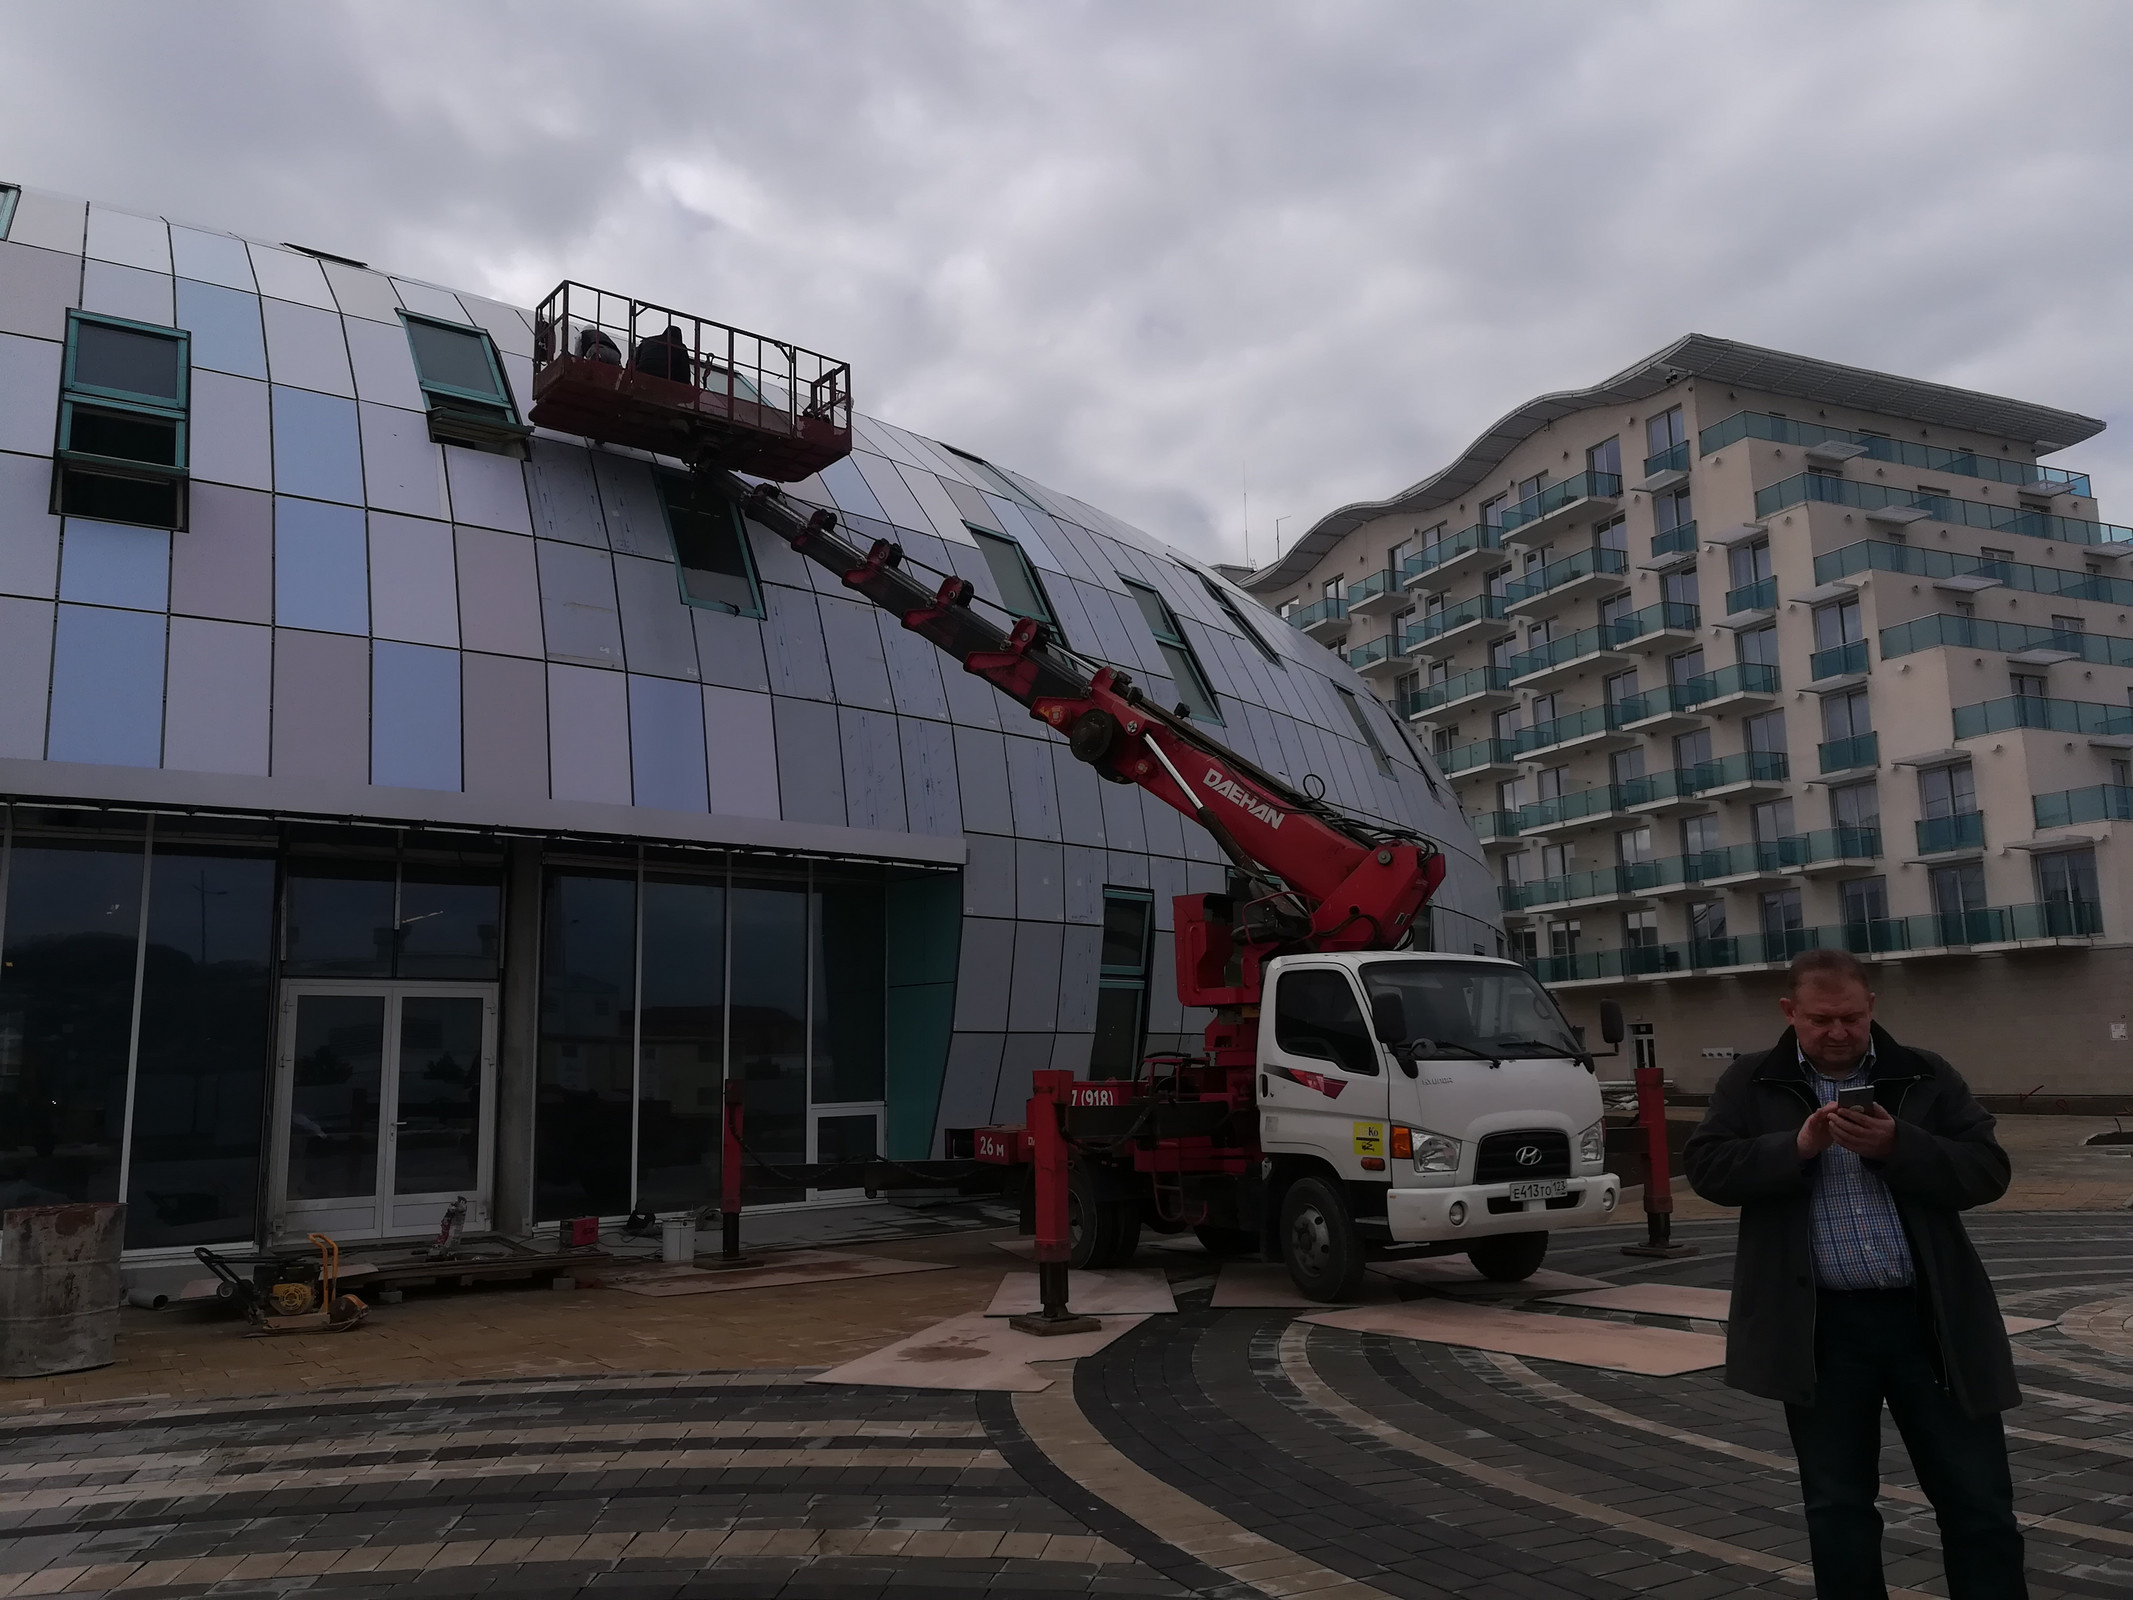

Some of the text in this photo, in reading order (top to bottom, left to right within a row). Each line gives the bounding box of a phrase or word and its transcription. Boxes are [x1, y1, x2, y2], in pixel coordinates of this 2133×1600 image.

[1203, 768, 1285, 830] DAEHAN
[1081, 1089, 1114, 1106] (918)
[980, 1136, 994, 1156] 26
